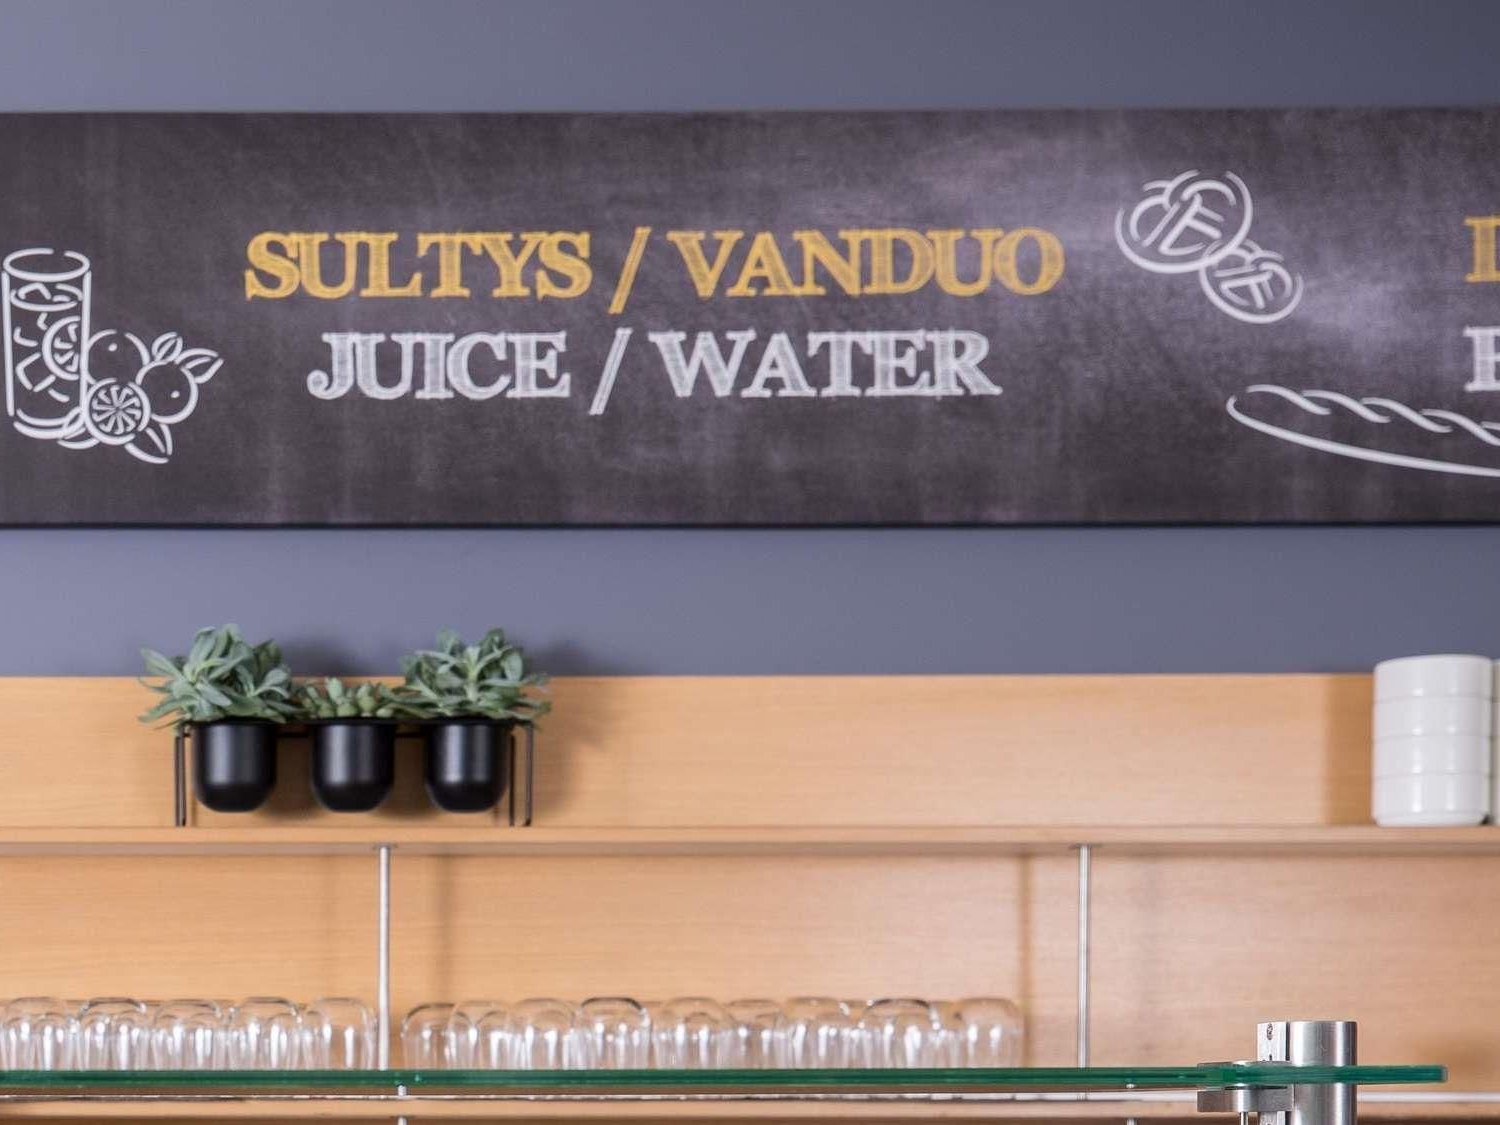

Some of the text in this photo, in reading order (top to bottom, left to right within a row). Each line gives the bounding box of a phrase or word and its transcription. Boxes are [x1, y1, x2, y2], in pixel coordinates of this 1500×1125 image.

[243, 226, 1067, 315] SULTYS / VANDUO
[306, 327, 1003, 415] JUICE / WATER
